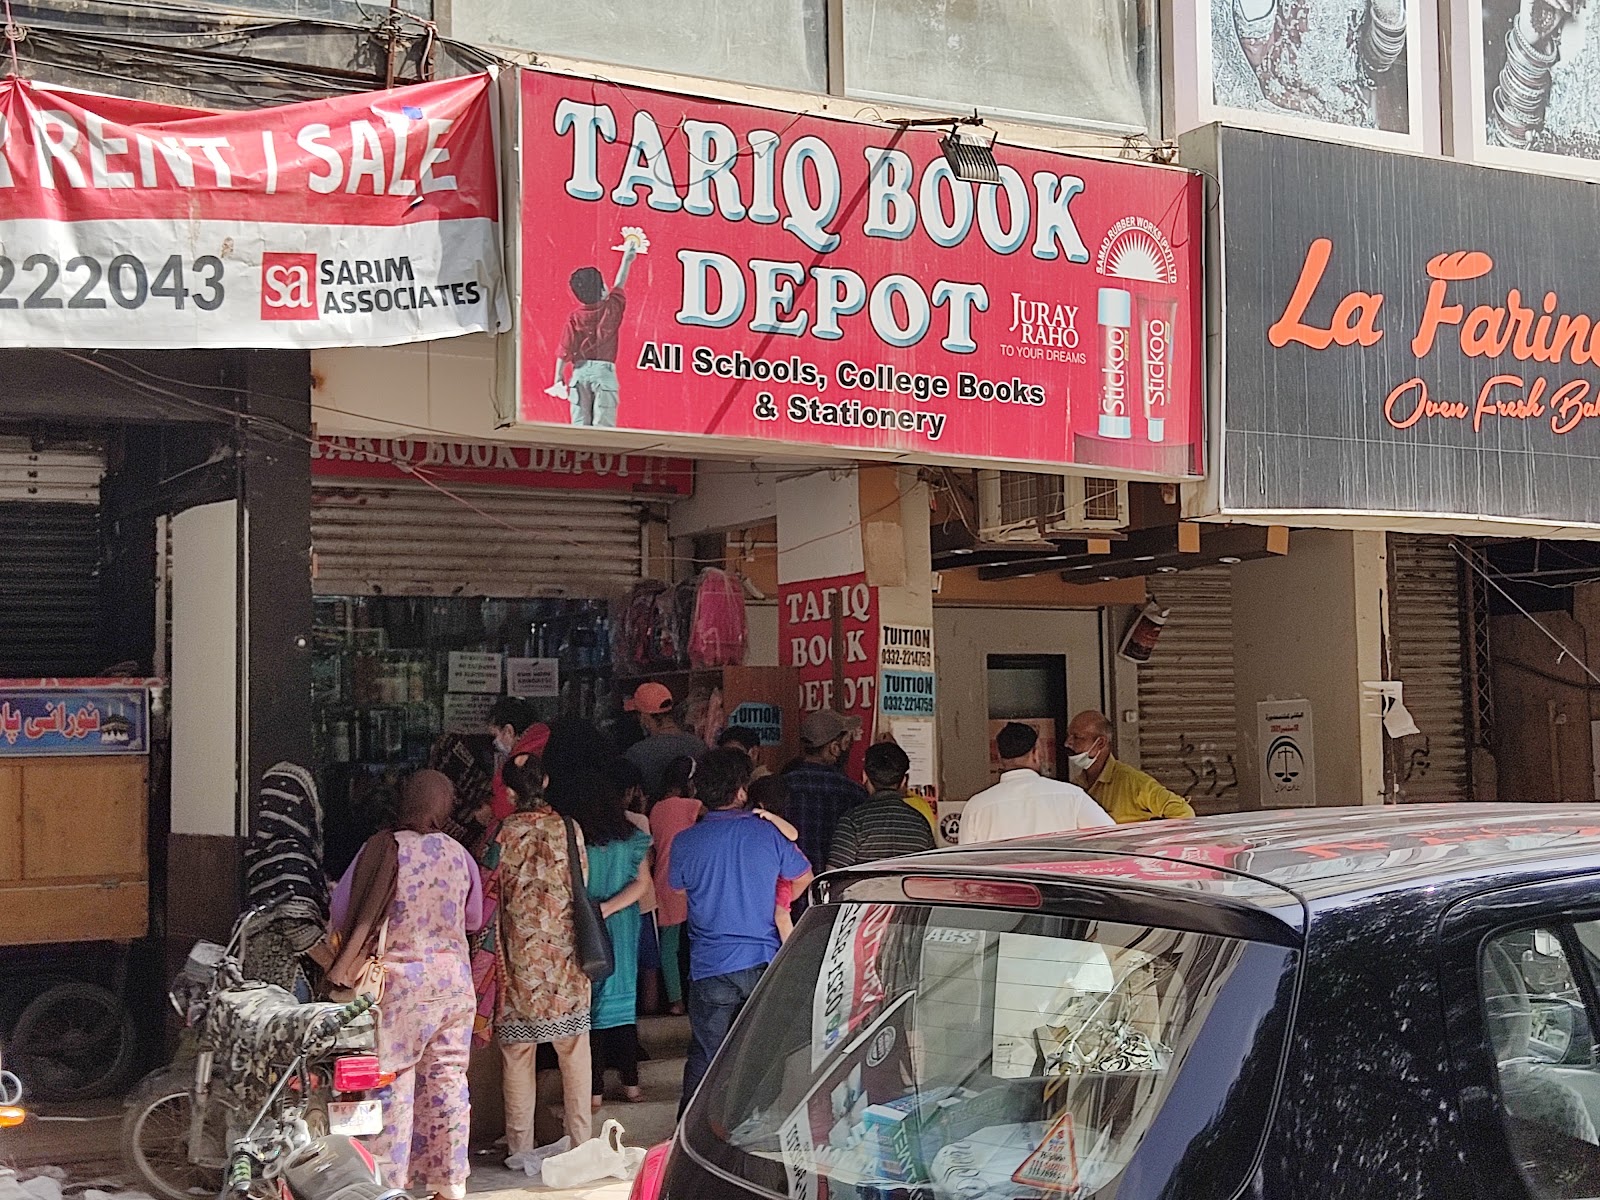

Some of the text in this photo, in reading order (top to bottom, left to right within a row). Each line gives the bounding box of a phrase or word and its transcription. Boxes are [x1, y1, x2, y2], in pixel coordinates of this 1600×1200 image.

[31, 108, 234, 190] RENT
[297, 105, 458, 197] SALE
[554, 98, 1090, 264] TARIQ BOOK
[320, 256, 415, 285] SARIM
[1095, 237, 1110, 274] SAMAD
[1107, 216, 1137, 241] RUBBER
[1136, 216, 1163, 241] WORKS
[1168, 263, 1177, 284] LTD
[323, 281, 482, 315] ASSOCIATES
[675, 248, 989, 354] DEPOT
[1008, 292, 1079, 332] JURAY
[1267, 237, 1385, 351] La
[1000, 344, 1087, 365] TO YOUR DREAMS
[1021, 323, 1080, 349] RAHO
[637, 343, 1046, 407] All Schools, College Books
[1101, 328, 1125, 415] Stickoo
[1146, 319, 1165, 407] Stickoo
[752, 393, 946, 440] & Stationery
[1384, 377, 1469, 429] Oven
[1473, 374, 1546, 434] Fresh
[426, 442, 519, 469] BOOK
[529, 447, 629, 477] DEPOT
[883, 625, 930, 648] TUITION
[884, 674, 933, 694] TUITION
[925, 928, 978, 944] ABS
